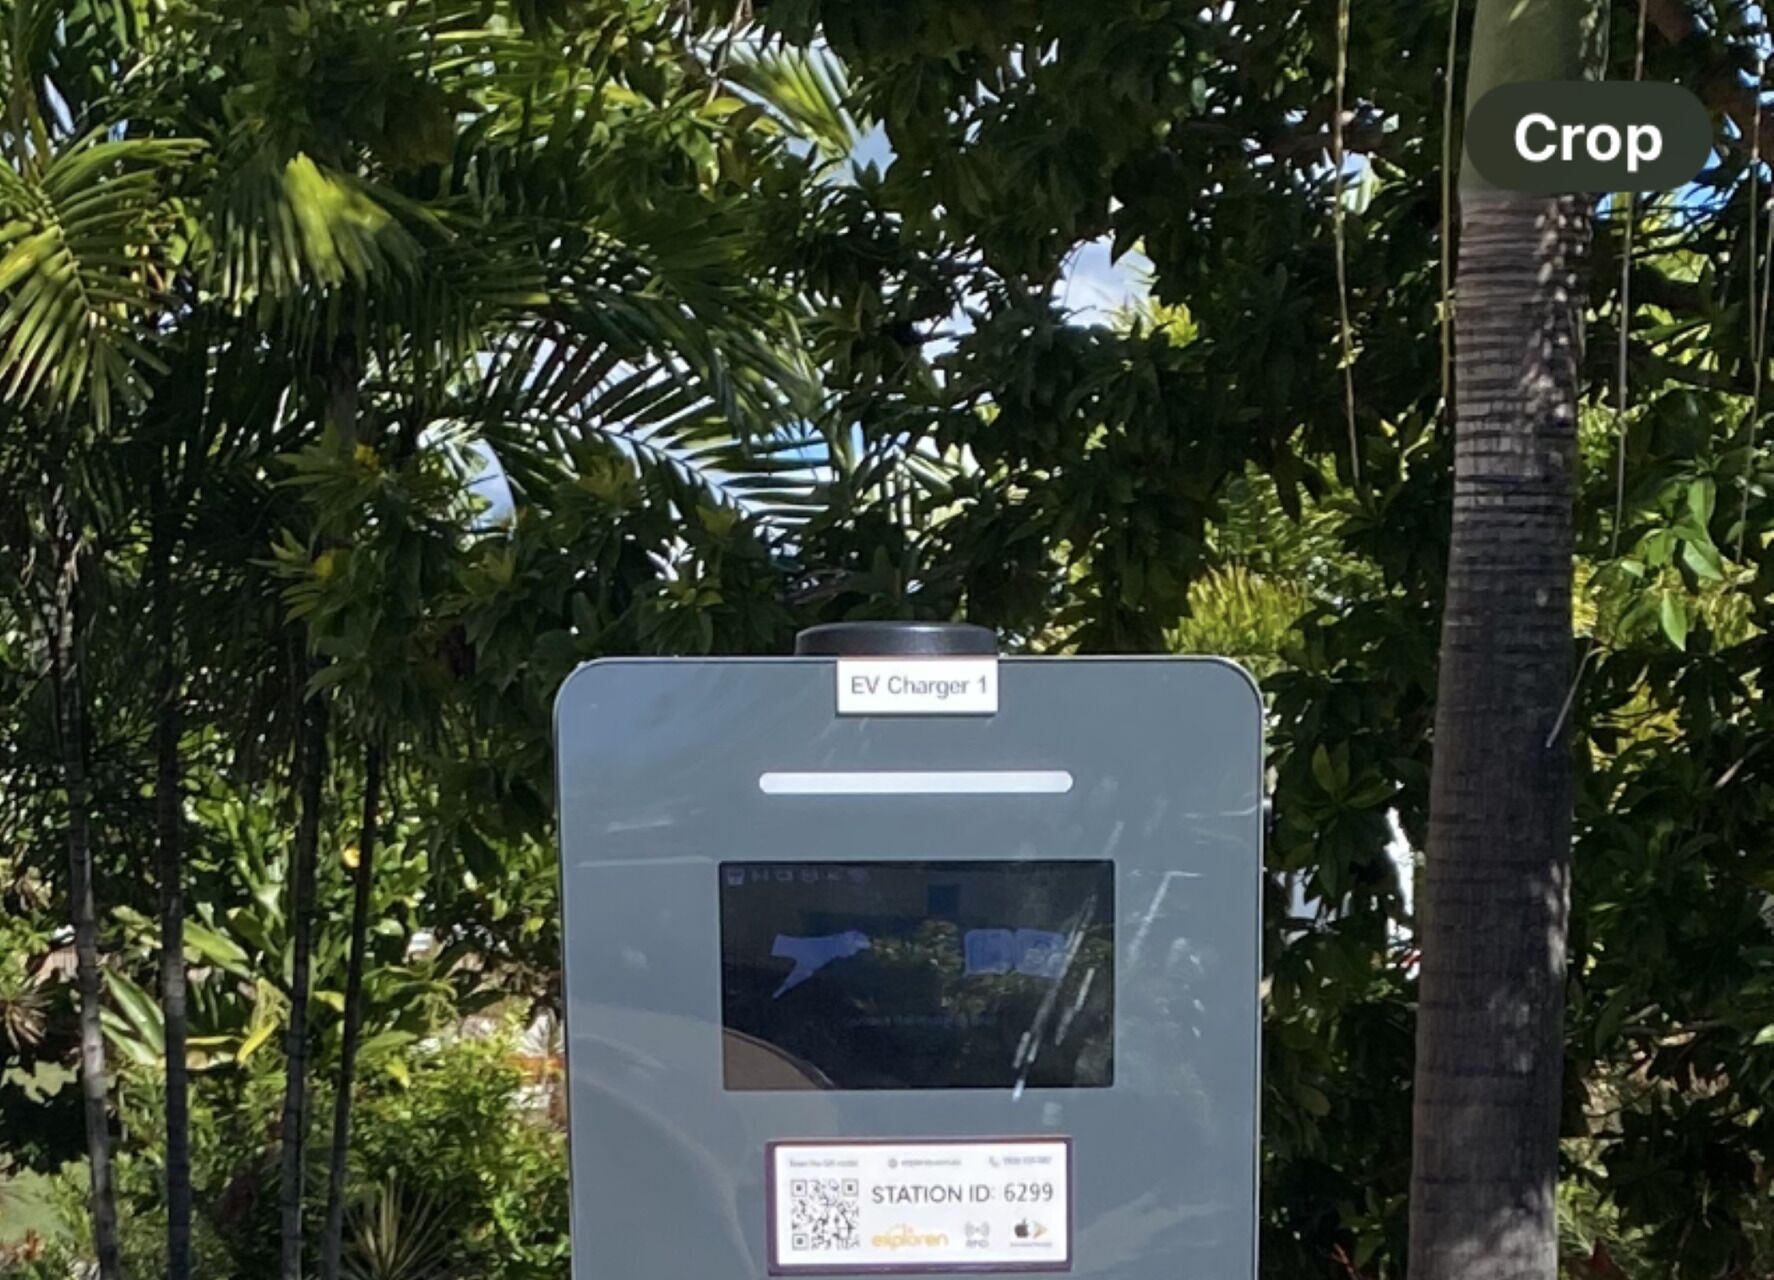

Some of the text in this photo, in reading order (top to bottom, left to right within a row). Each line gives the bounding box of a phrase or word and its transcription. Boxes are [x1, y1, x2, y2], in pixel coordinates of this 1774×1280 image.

[850, 675, 988, 700] EV Charger 1
[871, 1185, 963, 1205] STATION
[1003, 1182, 1054, 1203] 6299
[871, 1224, 949, 1248] exploren
